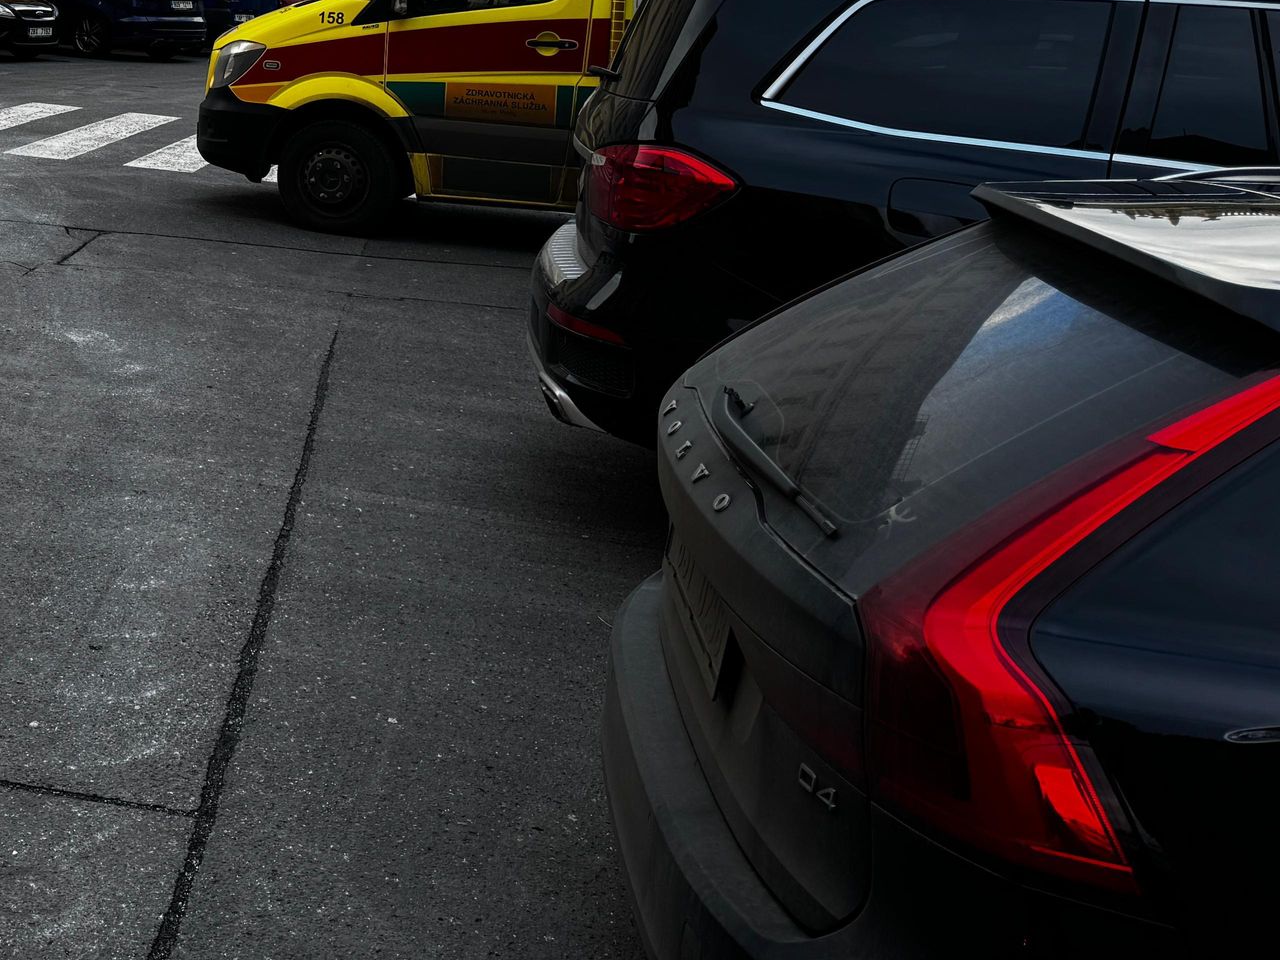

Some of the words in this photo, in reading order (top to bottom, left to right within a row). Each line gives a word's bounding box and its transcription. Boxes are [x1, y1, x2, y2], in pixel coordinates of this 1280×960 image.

[319, 12, 344, 24] 158
[466, 89, 535, 100] ZDRAVOTNICKÁ
[453, 96, 508, 108] ZÁCHRANNÁ
[511, 100, 548, 111] SLUŽBA
[663, 399, 731, 512] VOLVO
